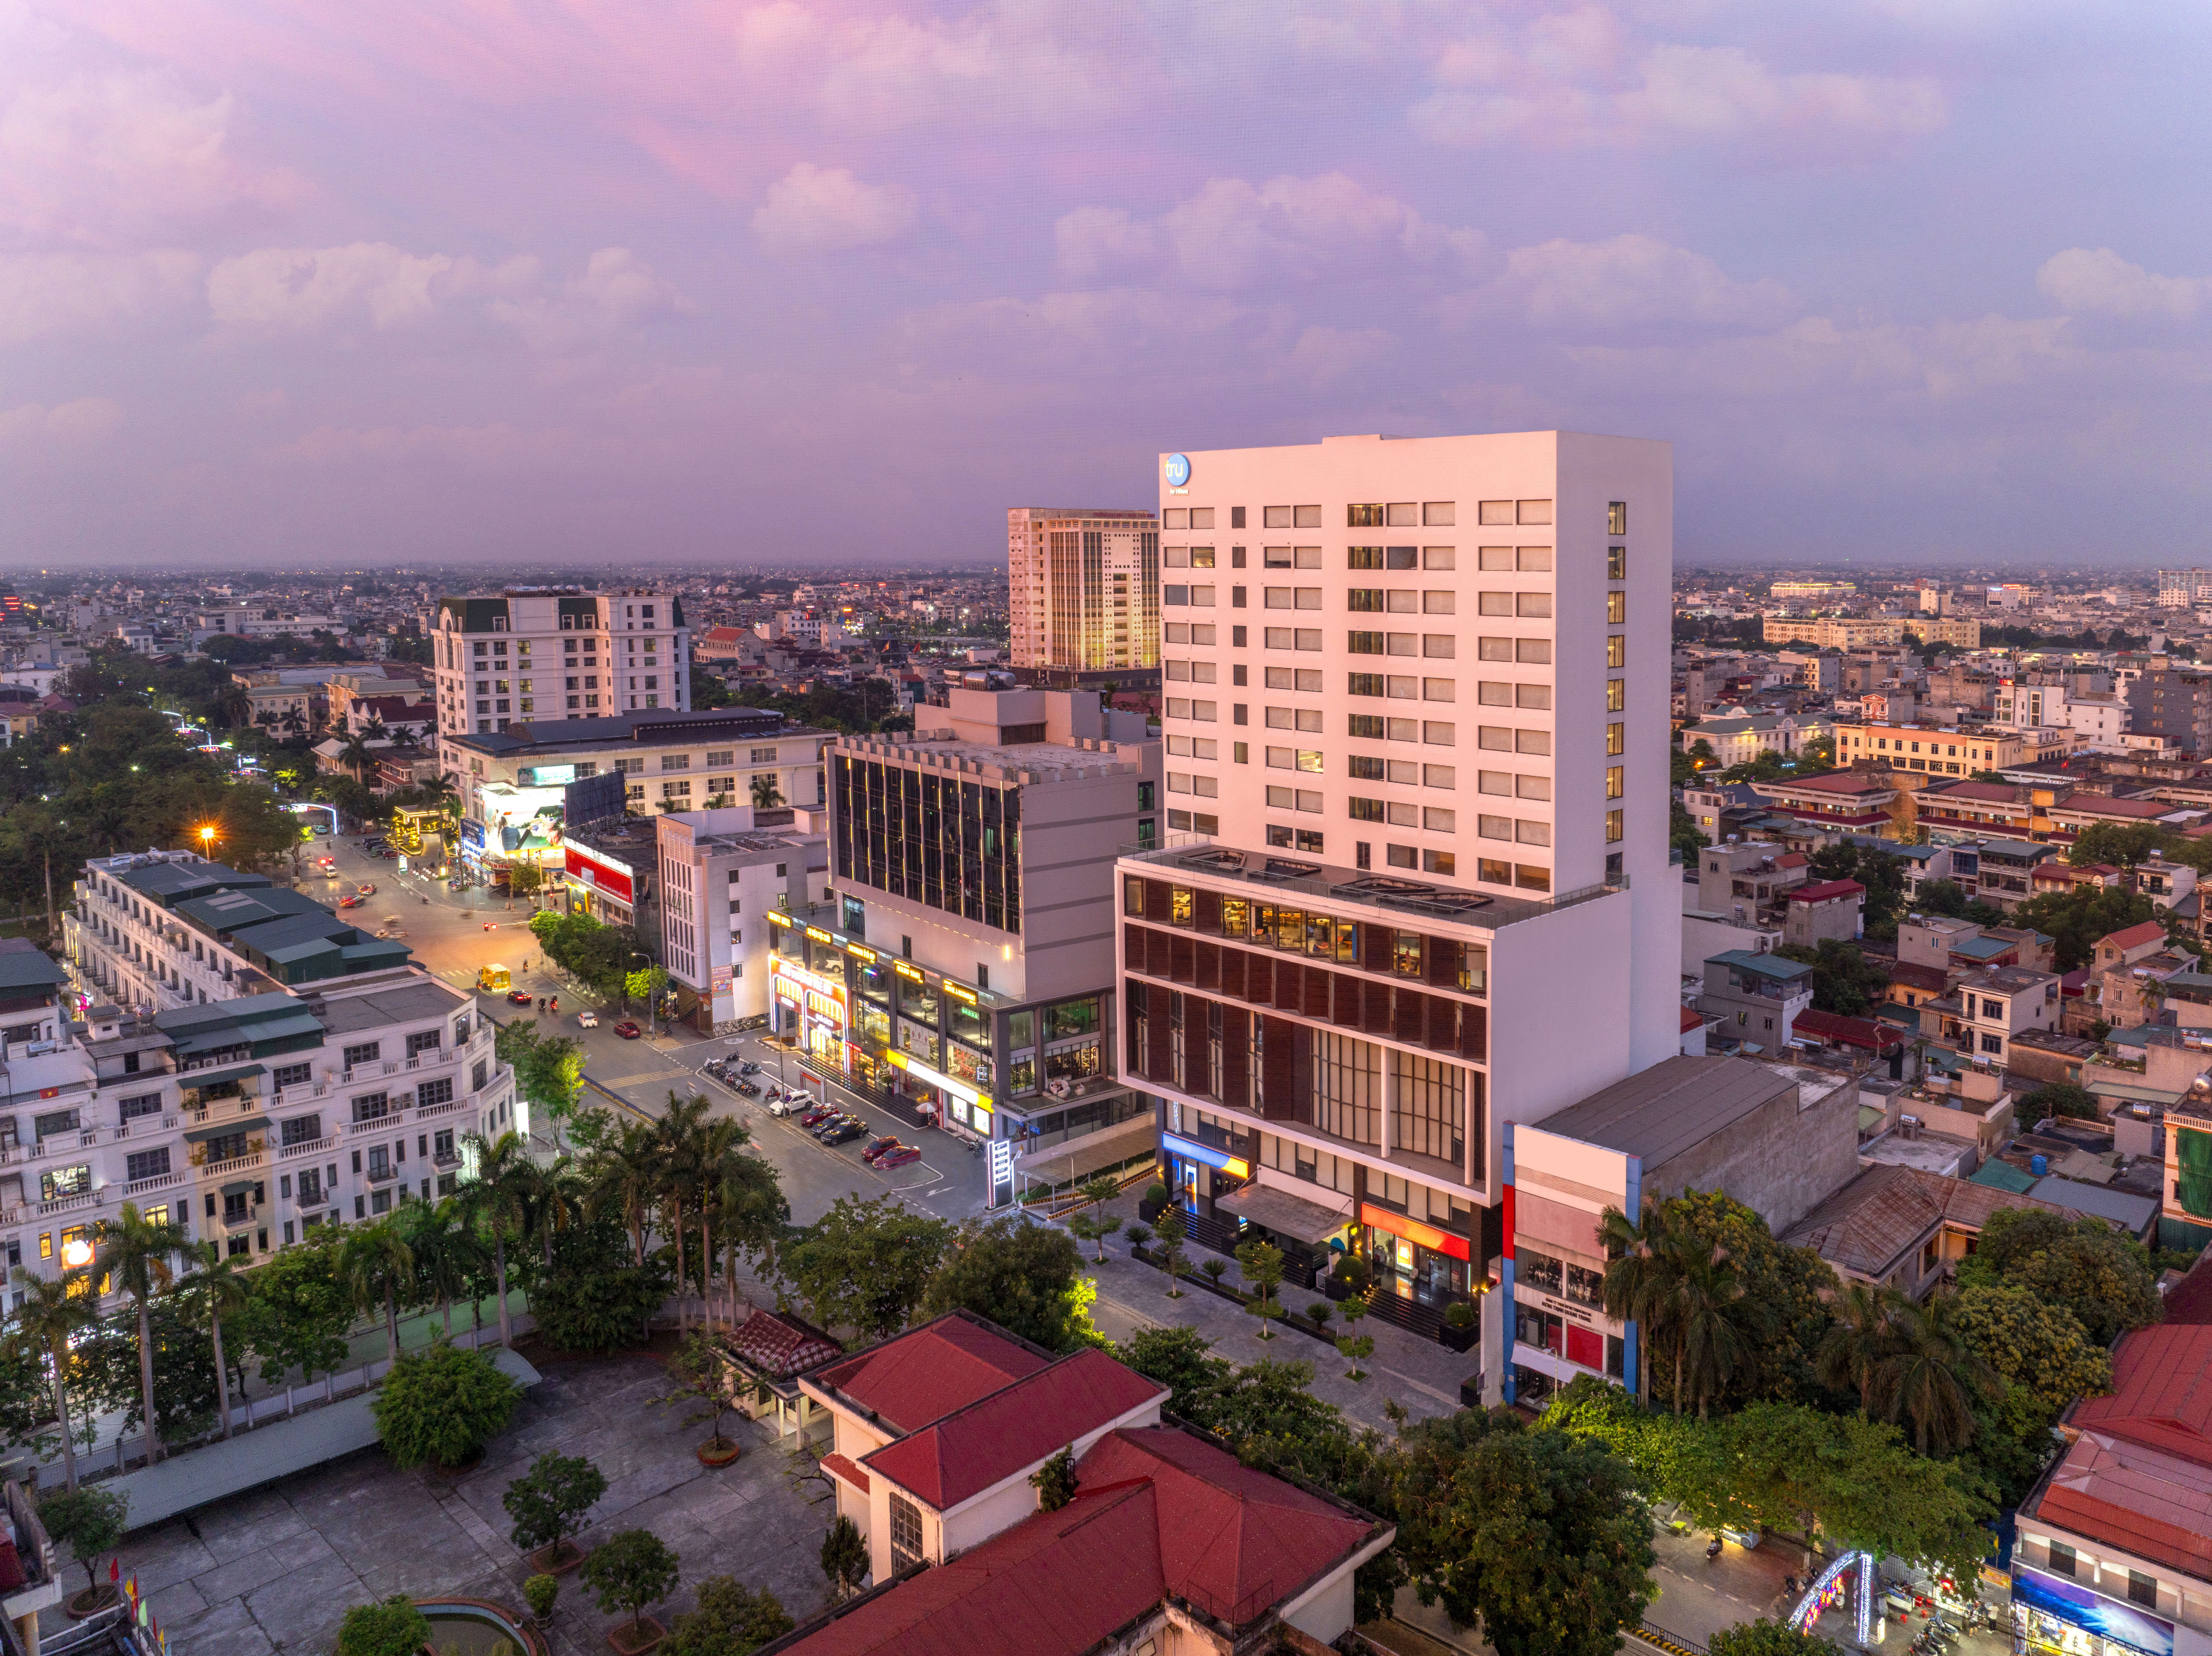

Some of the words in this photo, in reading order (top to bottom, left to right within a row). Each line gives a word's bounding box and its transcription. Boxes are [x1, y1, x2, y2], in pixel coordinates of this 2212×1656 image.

[1165, 460, 1183, 477] tru
[1565, 1309, 1577, 1318] QUANG
[1578, 1314, 1591, 1323] TRUNG
